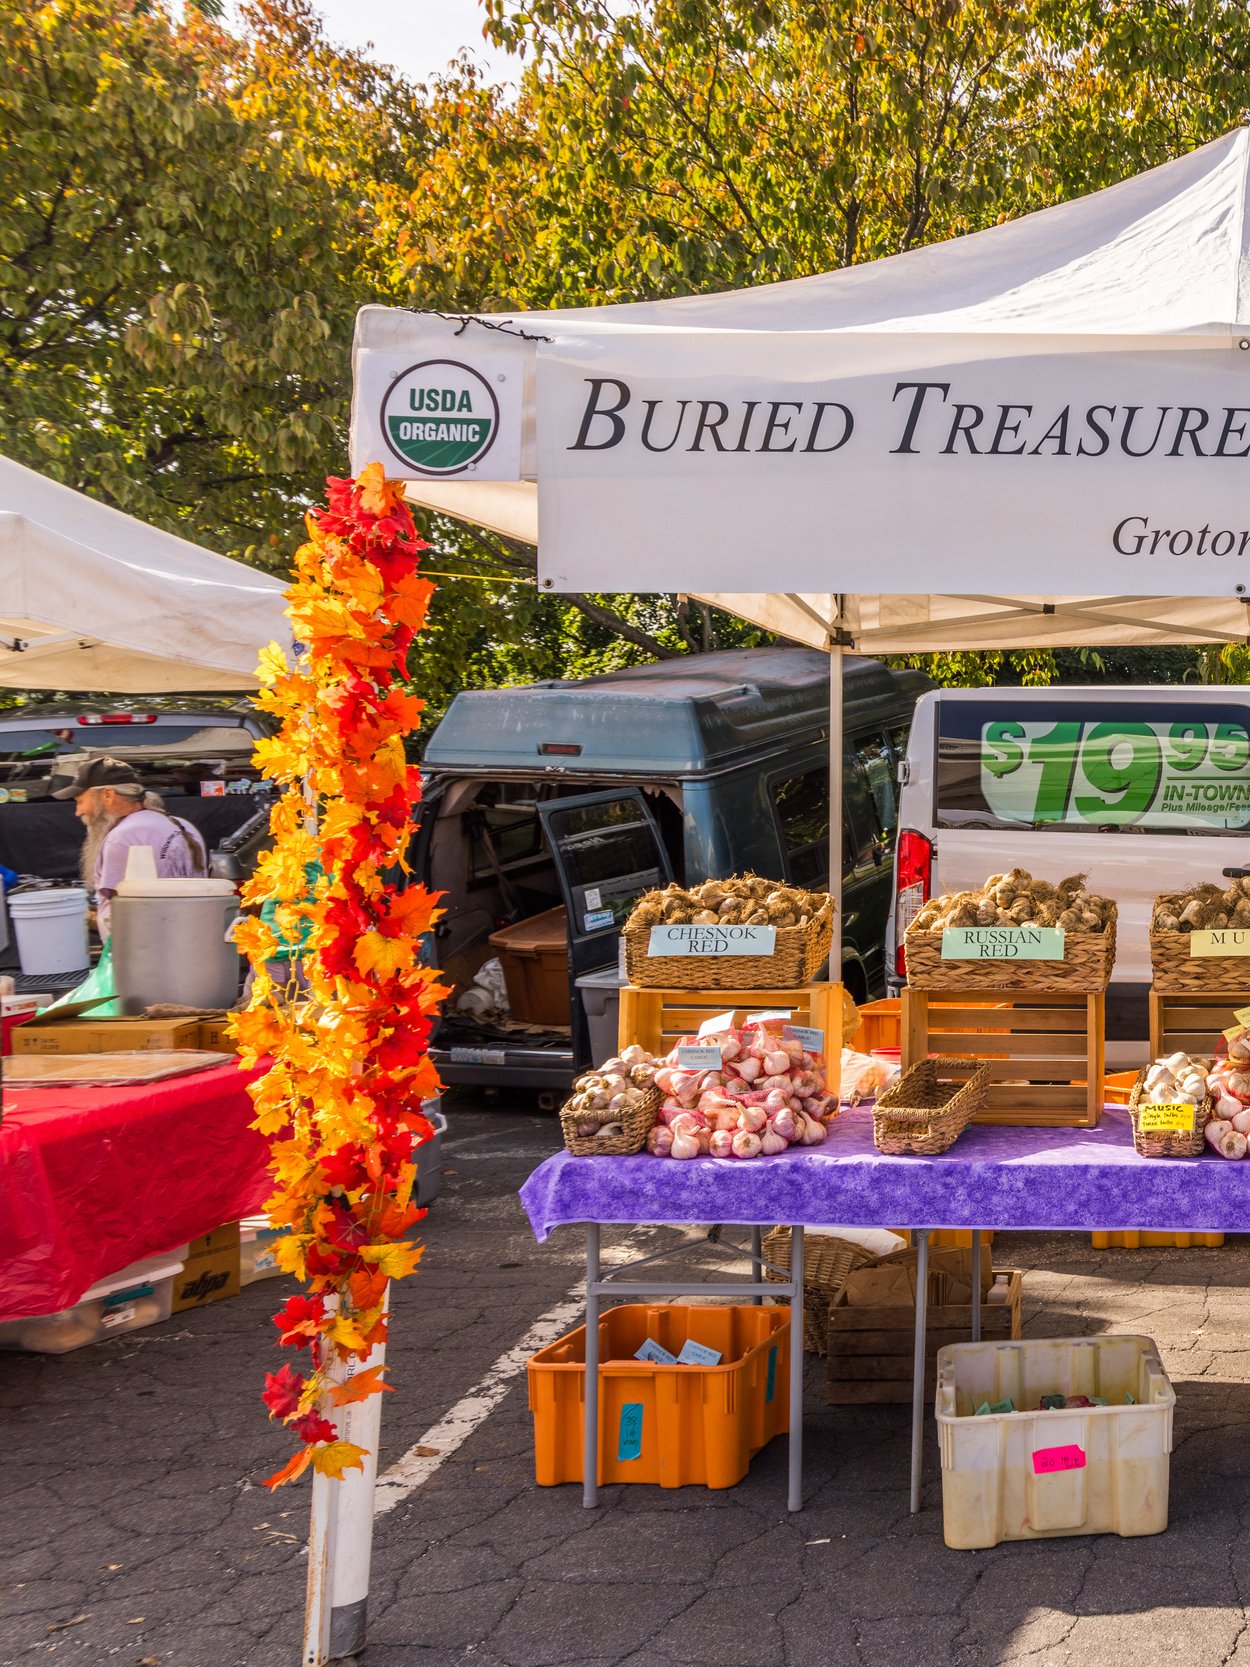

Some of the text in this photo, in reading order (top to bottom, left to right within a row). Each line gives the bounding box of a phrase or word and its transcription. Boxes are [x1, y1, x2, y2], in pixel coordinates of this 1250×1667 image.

[408, 388, 473, 413] USDA
[566, 377, 855, 453] BURIED
[399, 421, 481, 443] ORGANIC
[1161, 802, 1184, 812] Plus
[668, 927, 758, 940] CHESNOK
[964, 931, 1042, 944] RUSSIAN
[688, 940, 728, 952] RED
[978, 944, 1018, 958] RED
